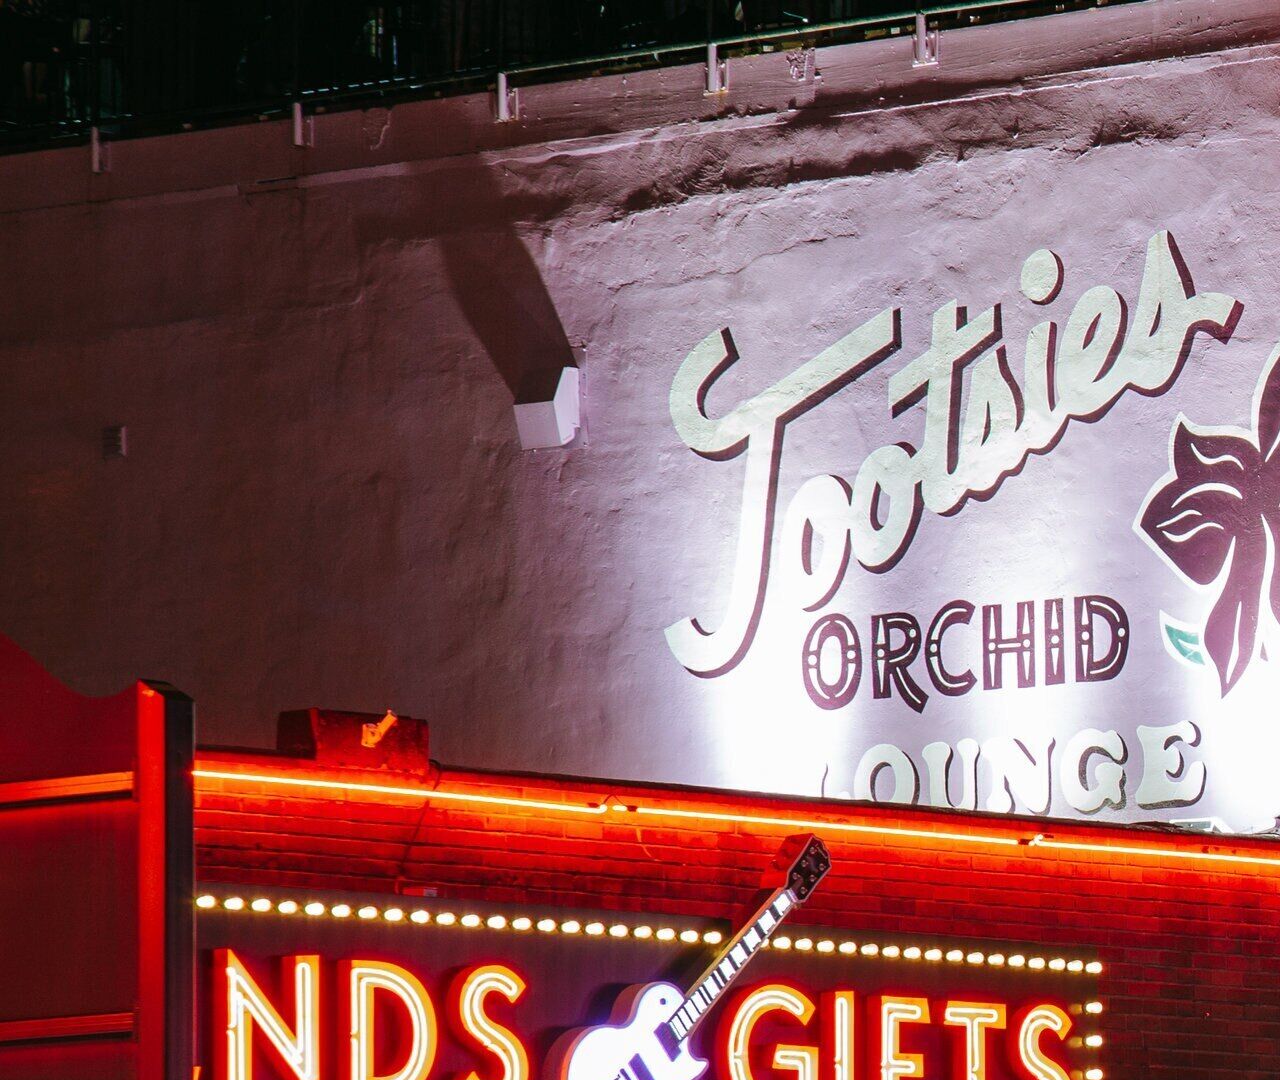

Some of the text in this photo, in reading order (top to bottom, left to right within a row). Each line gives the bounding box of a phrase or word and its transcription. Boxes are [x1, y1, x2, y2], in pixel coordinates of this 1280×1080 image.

[664, 229, 1243, 679] Tootsies
[801, 594, 1130, 713] ORCHID
[820, 721, 1208, 813] OUNGE
